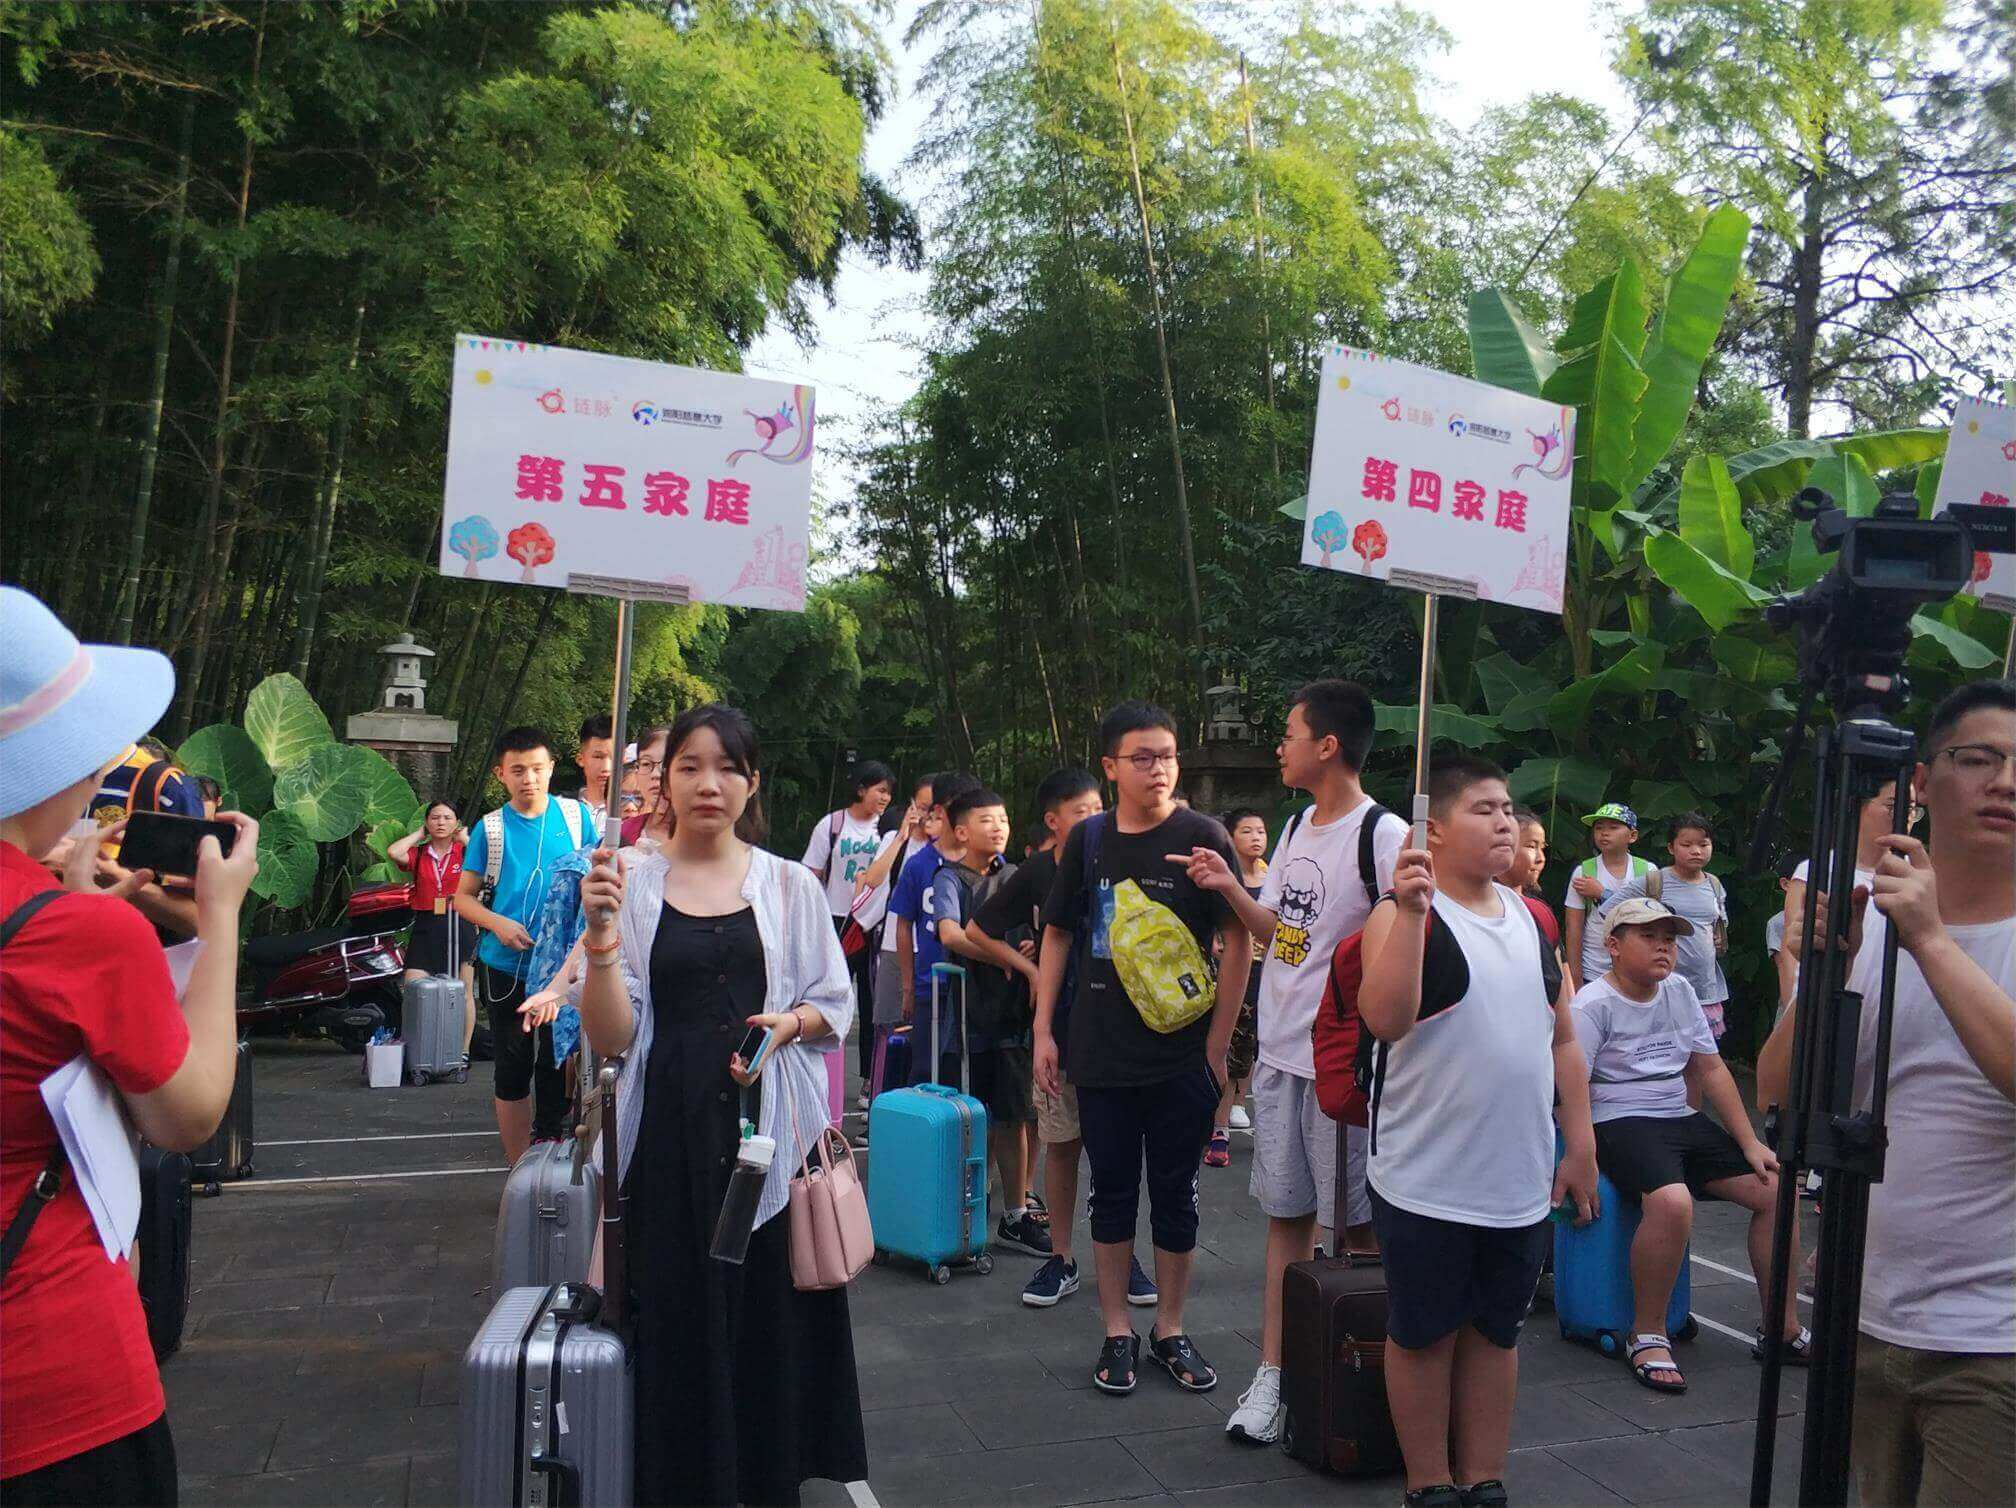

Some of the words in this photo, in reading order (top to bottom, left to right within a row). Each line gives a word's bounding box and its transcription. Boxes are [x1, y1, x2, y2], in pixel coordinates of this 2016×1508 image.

[515, 454, 751, 525] 第五家庭
[1361, 456, 1528, 532] 第四家庭
